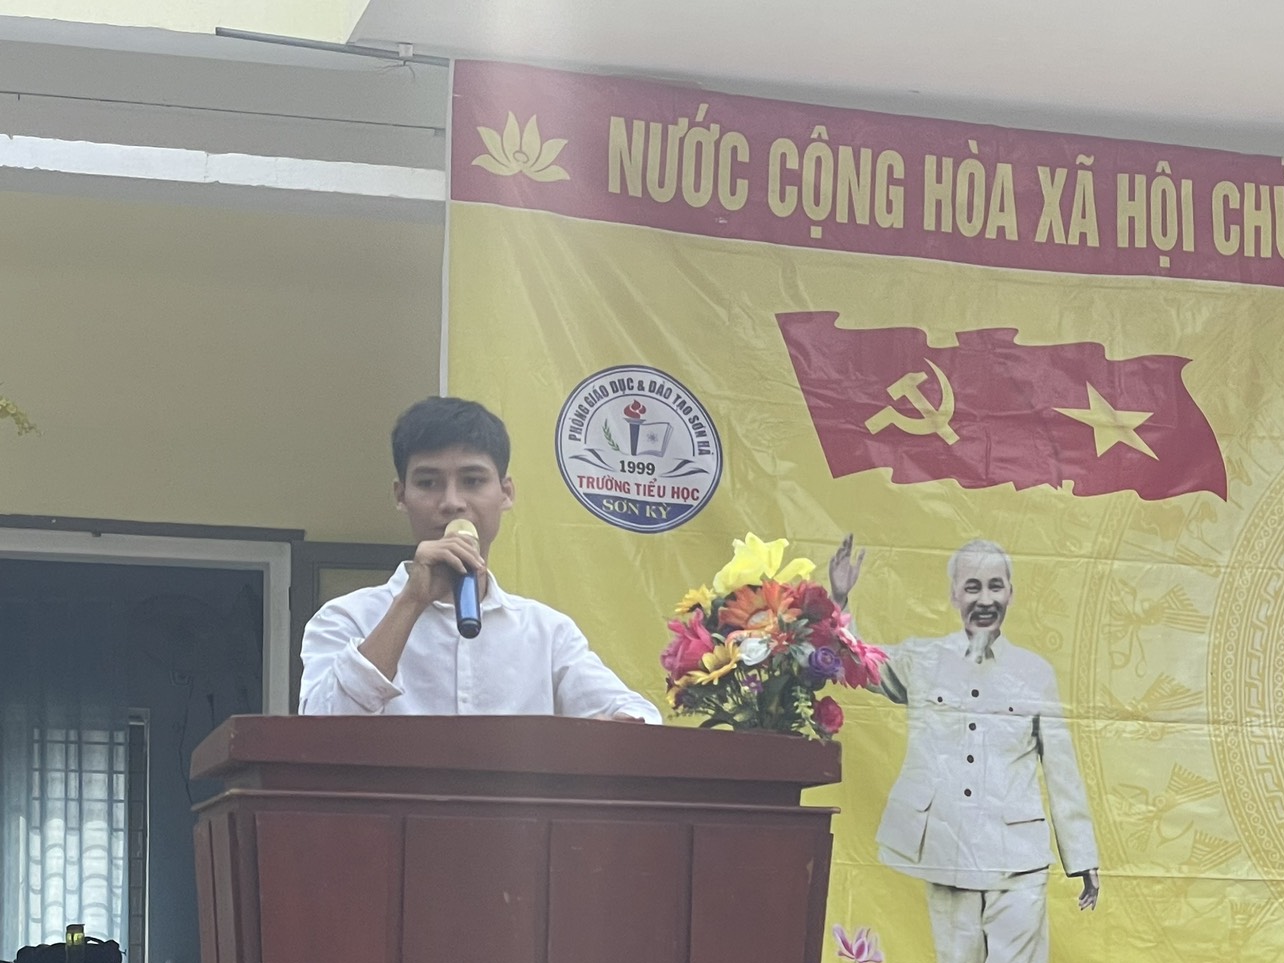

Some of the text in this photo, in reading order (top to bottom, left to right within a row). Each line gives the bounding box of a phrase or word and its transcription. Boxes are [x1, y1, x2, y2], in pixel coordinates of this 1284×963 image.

[607, 104, 749, 210] NƯỚC
[768, 125, 904, 239] CỘNG
[924, 139, 1018, 241] HÒA
[1035, 154, 1100, 248] XÃ
[1116, 160, 1195, 267] HỘI
[568, 404, 590, 442] PHÒNG
[584, 384, 609, 408] GIÁO
[609, 377, 634, 395] DỤC
[637, 380, 646, 392] &
[671, 394, 693, 416] TẠO
[688, 414, 707, 438] SƠN
[619, 460, 656, 476] 1999
[577, 474, 700, 503] TRƯỜNG TIỂU HỌC
[602, 498, 640, 516] SƠN
